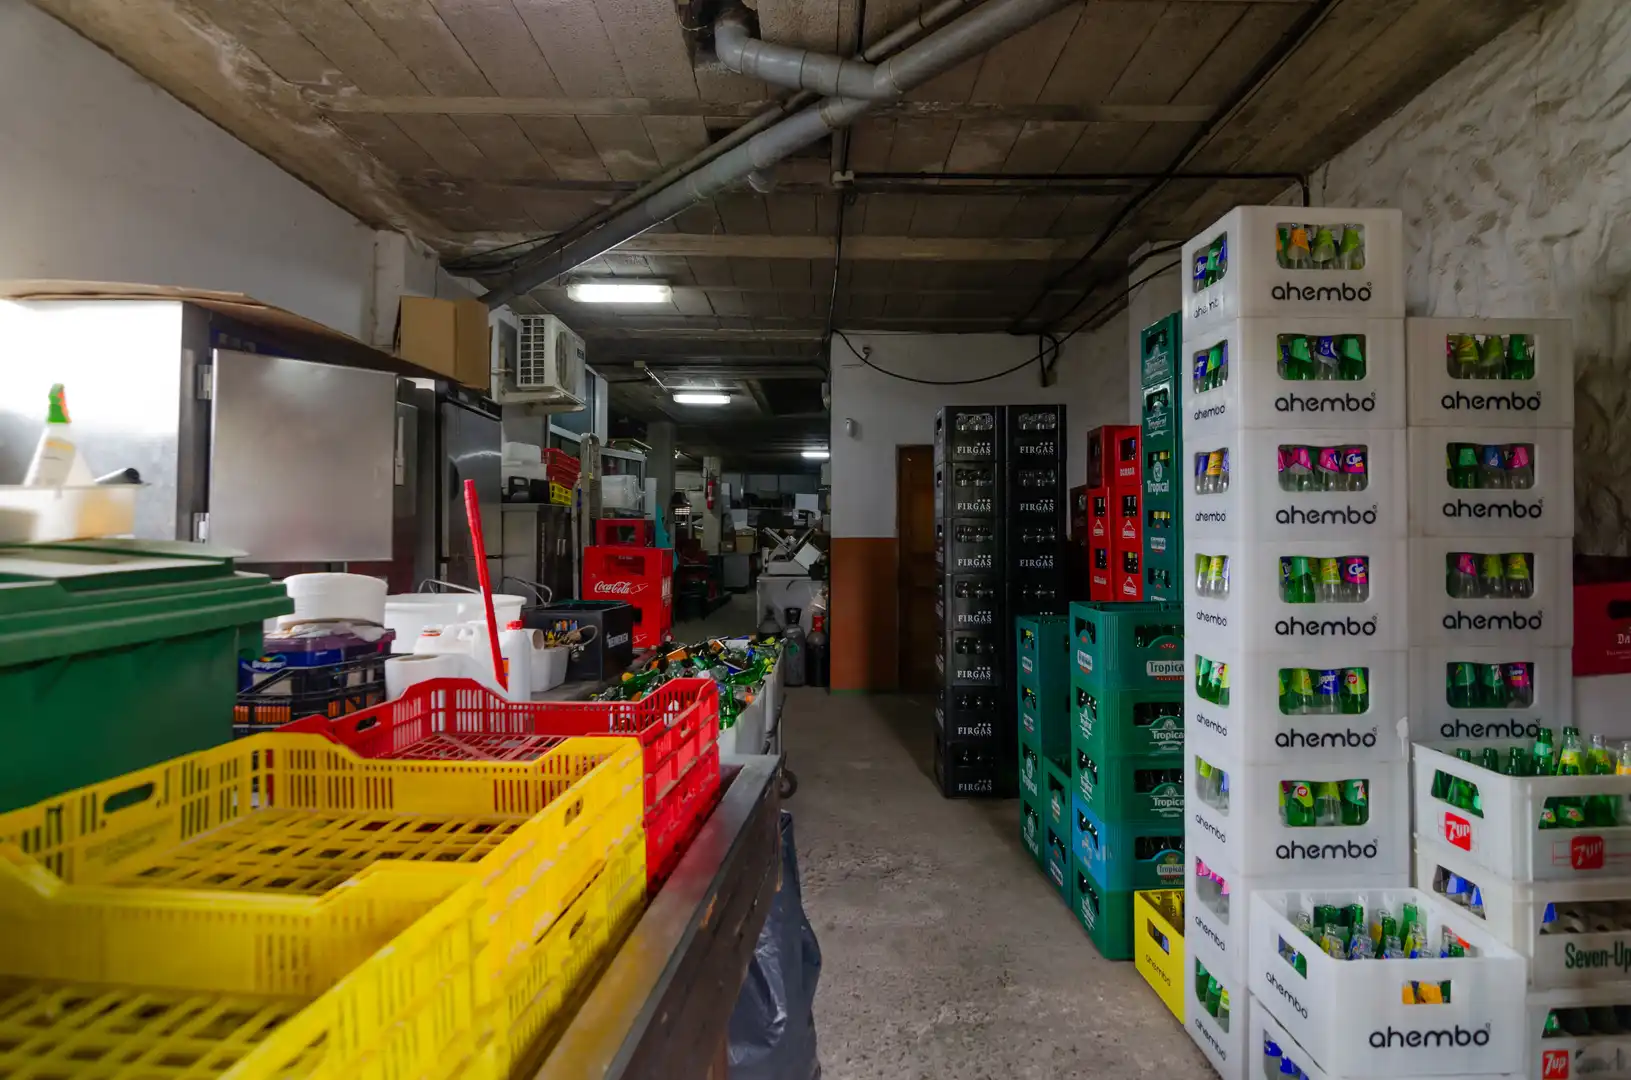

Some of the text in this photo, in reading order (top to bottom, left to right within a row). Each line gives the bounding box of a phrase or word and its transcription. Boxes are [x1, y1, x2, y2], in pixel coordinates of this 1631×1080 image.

[1272, 282, 1371, 301] ahembo
[1275, 393, 1375, 412] ahembo
[1442, 391, 1540, 410] ahembo
[1194, 404, 1225, 420] ahembo
[957, 446, 990, 454] FIRGAS
[1019, 446, 1053, 454] FIRGAS
[1147, 480, 1169, 495] Tropical
[957, 503, 990, 511] FIRGAS
[1020, 503, 1053, 511] FIRGAS
[1276, 505, 1377, 524] ahembo
[1443, 499, 1542, 518] ahembo
[1195, 511, 1226, 522] ahembo
[957, 559, 991, 567] FIRGAS
[1019, 559, 1053, 567] FIRGAS
[957, 615, 991, 623] FIRGAS
[1197, 611, 1227, 626] ahembo
[1275, 617, 1376, 636] ahembo
[1443, 611, 1542, 630] ahembo
[957, 670, 990, 678] FIRGAS
[1149, 661, 1184, 674] Tropica
[957, 727, 991, 735] FIRGAS
[1197, 714, 1227, 736] ahembo
[1441, 719, 1539, 738] ahembo
[1152, 730, 1184, 740] Tropica
[1275, 729, 1376, 747] ahembo
[958, 784, 991, 792] FIRGAS
[1153, 797, 1184, 807] Tropica
[1196, 815, 1225, 843] ahembo
[1276, 840, 1377, 859] ahembo
[1195, 916, 1225, 951] ahembo
[1266, 972, 1308, 1019] ahembo
[1195, 1017, 1226, 1061] ahembo
[1369, 1025, 1489, 1048] ahembo
